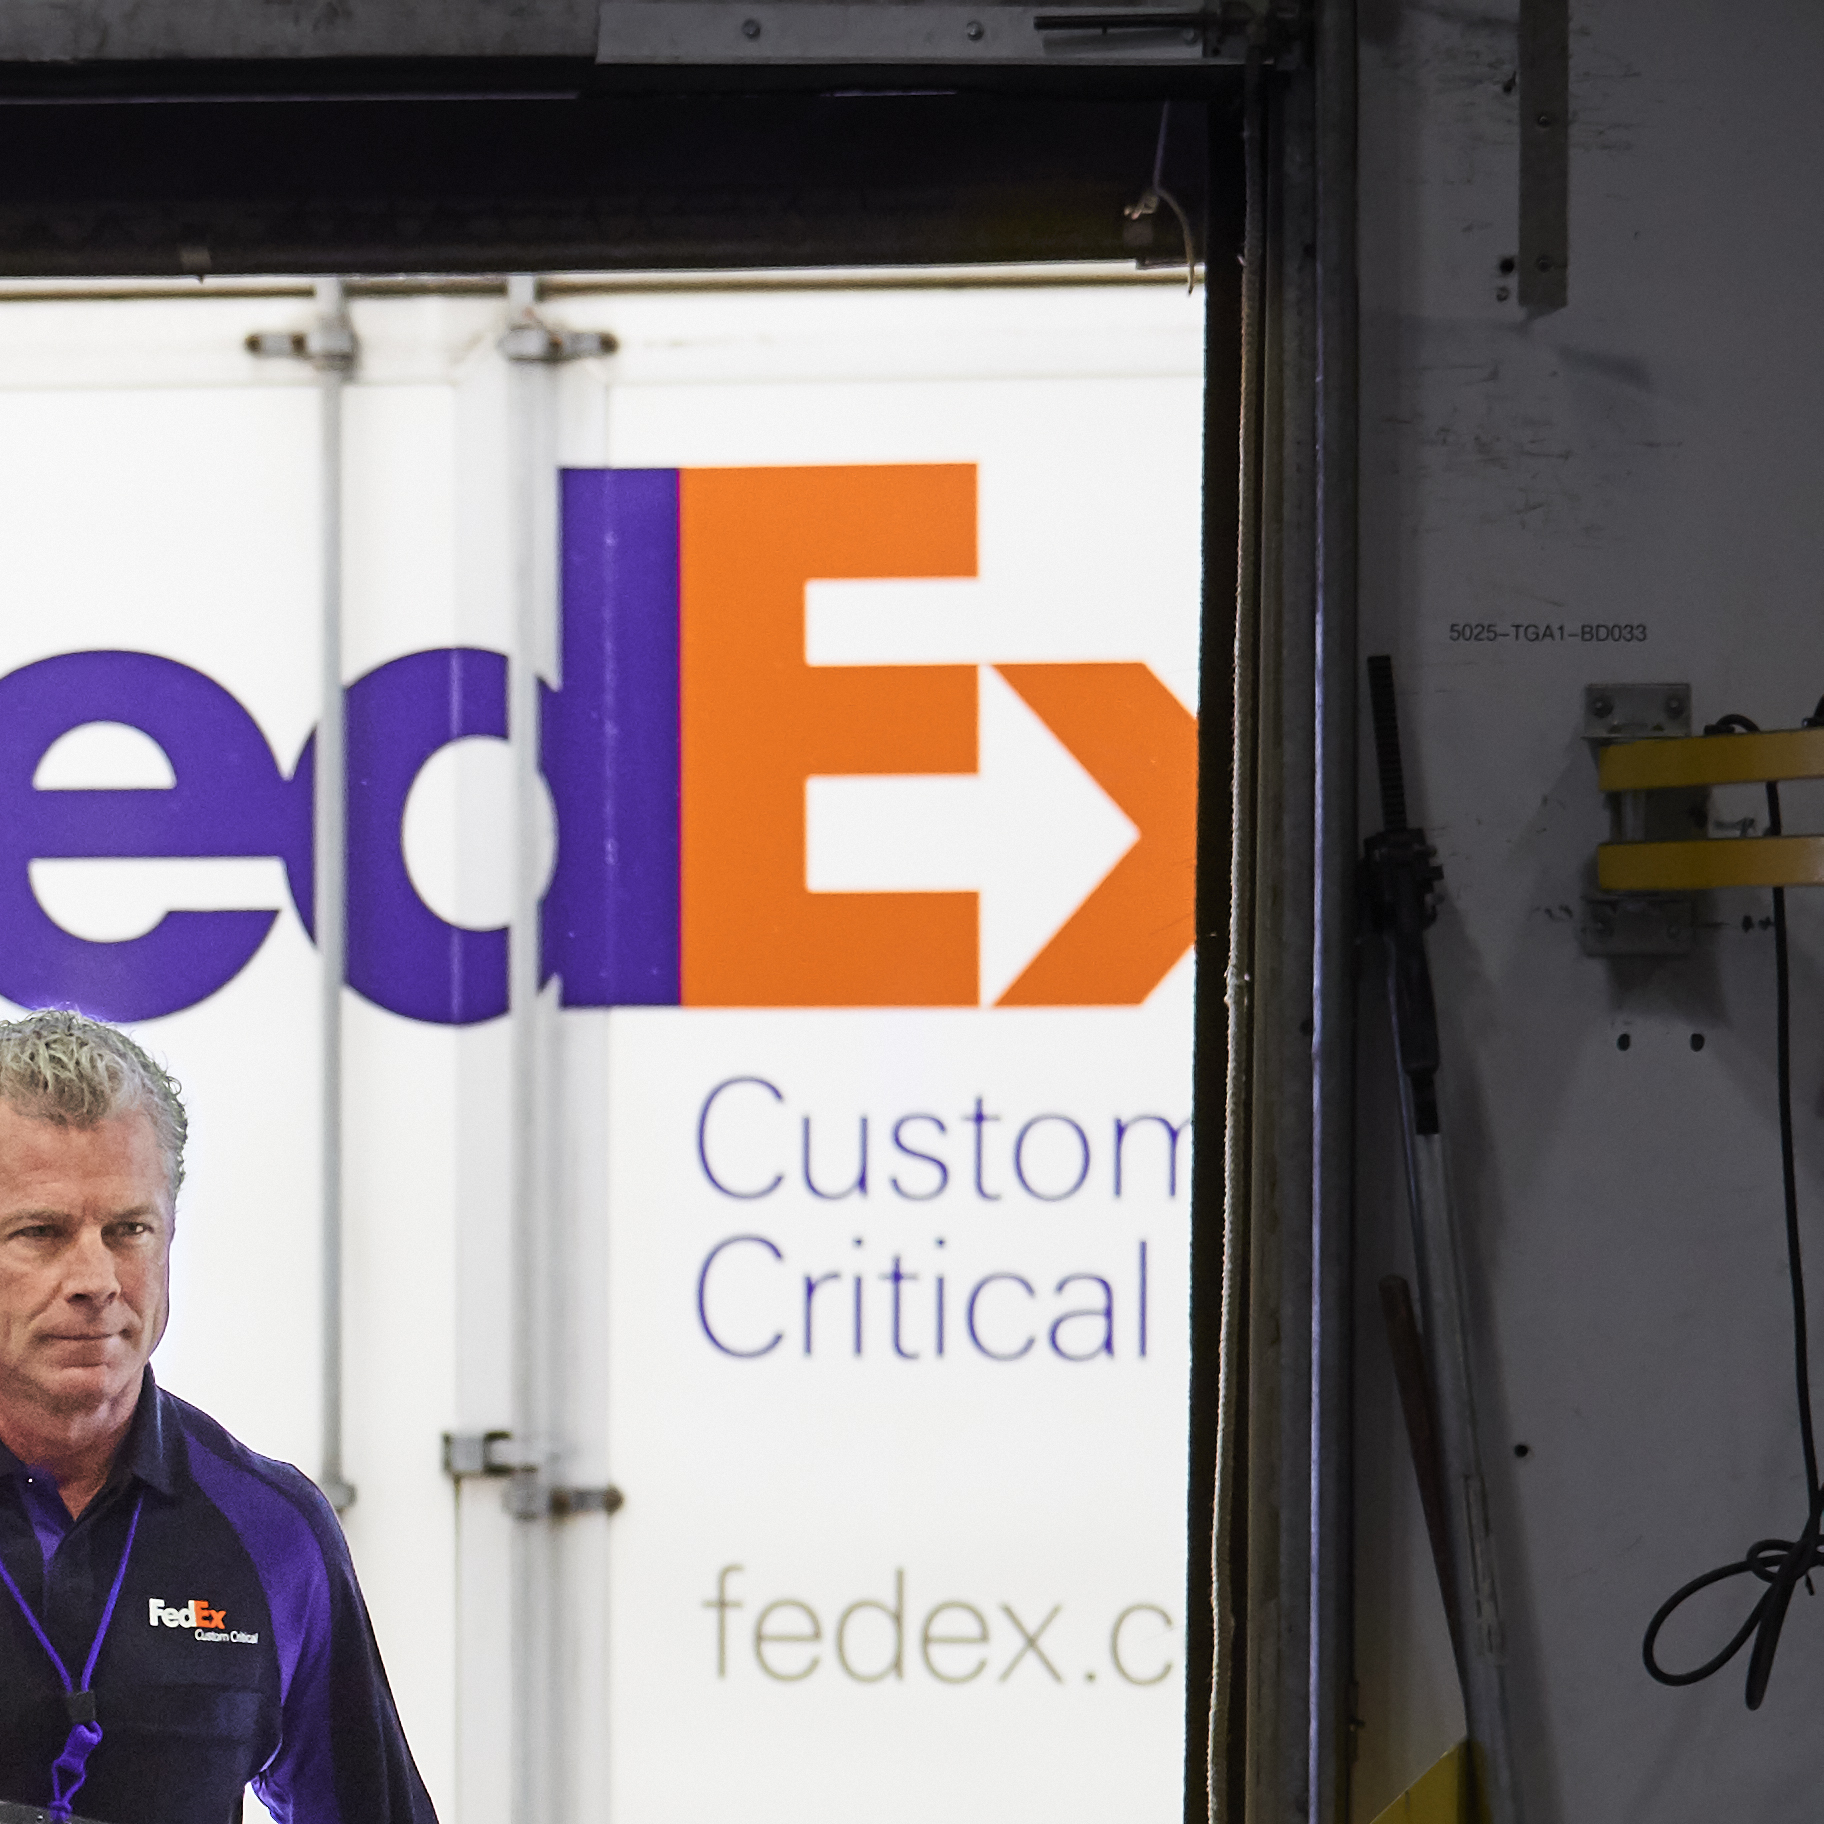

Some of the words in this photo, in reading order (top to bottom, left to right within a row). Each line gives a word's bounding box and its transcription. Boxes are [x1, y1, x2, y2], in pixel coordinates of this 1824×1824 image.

[1449, 623, 1647, 642] 5025-TGA1-BD033
[695, 1232, 1149, 1363] Critical
[148, 1597, 227, 1630] FedEx
